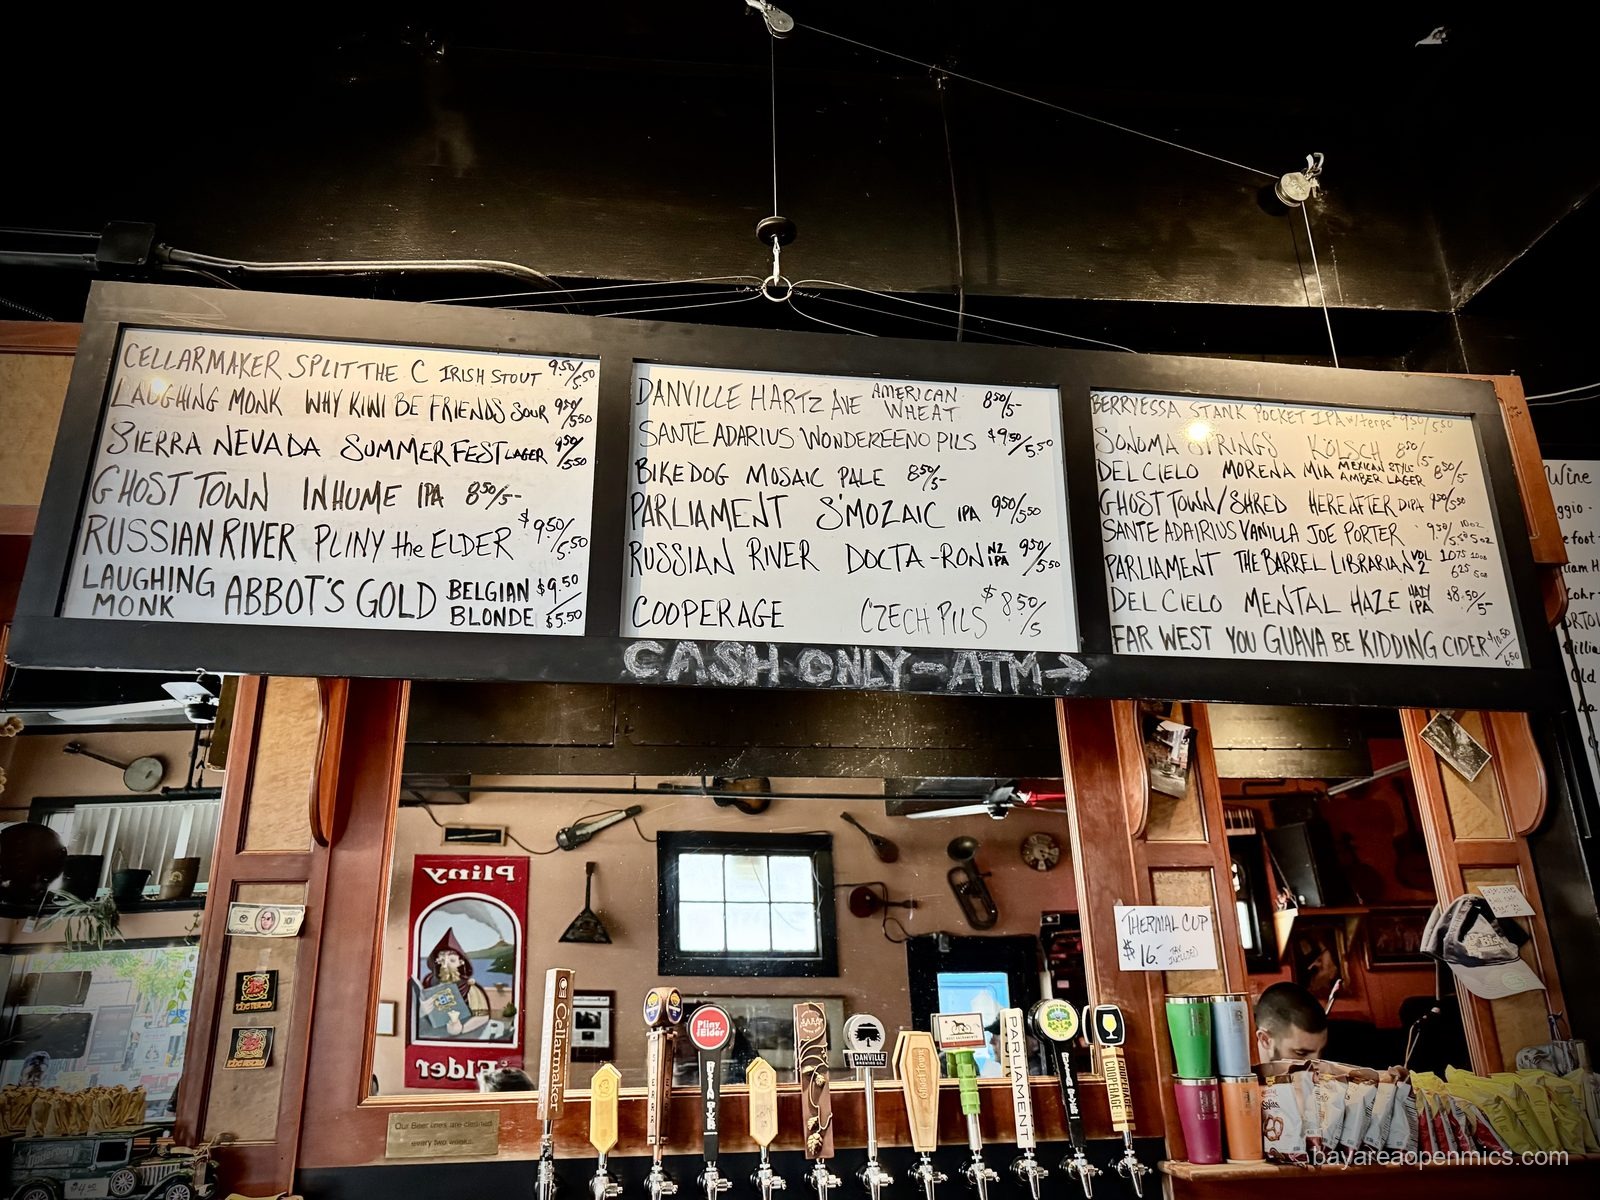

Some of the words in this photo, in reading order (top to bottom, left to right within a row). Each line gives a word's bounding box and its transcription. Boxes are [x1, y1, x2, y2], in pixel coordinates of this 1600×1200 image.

[124, 342, 282, 380] CELLARMAKER
[411, 359, 428, 383] C
[439, 365, 484, 385] IRISH
[491, 370, 542, 386] STOUT
[110, 376, 219, 408] LAUGHING
[228, 387, 282, 416] MONK
[306, 388, 343, 418] WHY
[350, 390, 386, 418] KIWI
[395, 392, 423, 417] BE
[430, 394, 505, 423] FRIENDS
[511, 402, 549, 424] SOUR
[636, 377, 743, 410] DANVILLE
[751, 384, 824, 414] HARTZ
[831, 388, 863, 420] AVE
[872, 383, 957, 403] AMERICAN
[884, 400, 959, 422] WHEAT
[1091, 394, 1181, 419] BERRYESSA
[1189, 401, 1246, 421] STANK
[1254, 403, 1306, 424] POCKET
[1312, 409, 1345, 428] IPA
[106, 421, 202, 458] SIERRA
[213, 424, 321, 458] NEVADA
[505, 448, 548, 464] LAGER
[639, 420, 709, 448] SANTE
[713, 423, 794, 448] ADARIUS
[799, 424, 930, 449] WONDEREENO
[937, 432, 977, 452] PILS
[1095, 426, 1179, 456] SONOMA
[746, 463, 824, 487] MOSAIC
[837, 466, 885, 488] PALE
[1143, 462, 1199, 483] CIELO
[1223, 459, 1296, 479] MORENA
[1304, 461, 1334, 480] MIA
[1338, 461, 1384, 473] MEXICAN
[1388, 463, 1414, 474] STYLE
[1340, 474, 1383, 486] AMBER
[1387, 475, 1425, 487] LAGER
[1544, 463, 1592, 485] Wine
[92, 464, 193, 506] GHOST
[194, 471, 268, 511] TOWN
[303, 474, 402, 514] INHUME
[418, 482, 444, 508] IPA
[1100, 488, 1164, 516] GHOST
[1308, 488, 1398, 518] HEREAFTER
[1399, 498, 1425, 514] DIPA
[631, 491, 788, 531] PARLIAMENT
[816, 493, 946, 530] S'MOZAIC
[957, 505, 981, 523] IPA
[1557, 504, 1583, 519] ggio
[83, 514, 214, 557] RUSSIAN
[220, 518, 297, 562] RIVER
[314, 524, 385, 563] PLINY
[391, 531, 425, 558] the
[431, 527, 514, 560] ELDER
[1102, 519, 1159, 543] SANTE
[1165, 519, 1236, 544] ADAIRIUS
[1239, 520, 1300, 544] VANILLA
[1307, 523, 1337, 545] JOE
[1344, 521, 1405, 547] PORTER
[629, 537, 735, 577] RUSSIAN
[746, 537, 820, 572] RIVER
[988, 542, 1007, 554] NZ
[988, 555, 1009, 567] IPA
[1105, 549, 1221, 582] PARLIAMENT
[1234, 549, 1260, 573] THE
[1261, 548, 1326, 575] BARREL
[1331, 550, 1414, 575] LIBRARIAN
[1411, 550, 1432, 561] VOL
[1419, 561, 1429, 574] 2
[83, 563, 215, 597] LAUGHING
[446, 578, 529, 603] BELGIAN
[92, 593, 174, 618] MONK
[224, 575, 345, 616] ABBOT'S
[357, 579, 437, 620] GOLD
[1111, 586, 1157, 612] DEL
[1162, 589, 1222, 613] CIELO
[1244, 584, 1342, 618] MENTAL
[1350, 584, 1400, 616] HAZE
[1410, 601, 1434, 614] IPA
[450, 606, 534, 626] BLONDE
[632, 595, 784, 628] COOPERAGE
[861, 598, 929, 634] CZECH
[937, 601, 987, 639] PILS
[1112, 625, 1153, 652] FAR
[1159, 624, 1212, 651] WEST
[1226, 626, 1257, 654] YOU
[1263, 624, 1329, 658] GUAVA
[1332, 631, 1354, 652] BE
[1359, 628, 1438, 660] KIDDING
[1443, 632, 1490, 657] CIDER
[623, 641, 780, 687] CASH
[948, 650, 1043, 695] ATM
[1122, 908, 1179, 935] THERMAL
[1182, 913, 1208, 932] CUP
[550, 1003, 567, 1112] Cellarmaker
[854, 1053, 885, 1062] DANVILLE
[1009, 1016, 1029, 1141] PARLIAMENT
[1105, 1061, 1122, 1109] COOPERAGE
[1118, 1061, 1131, 1108] COOPERAGE
